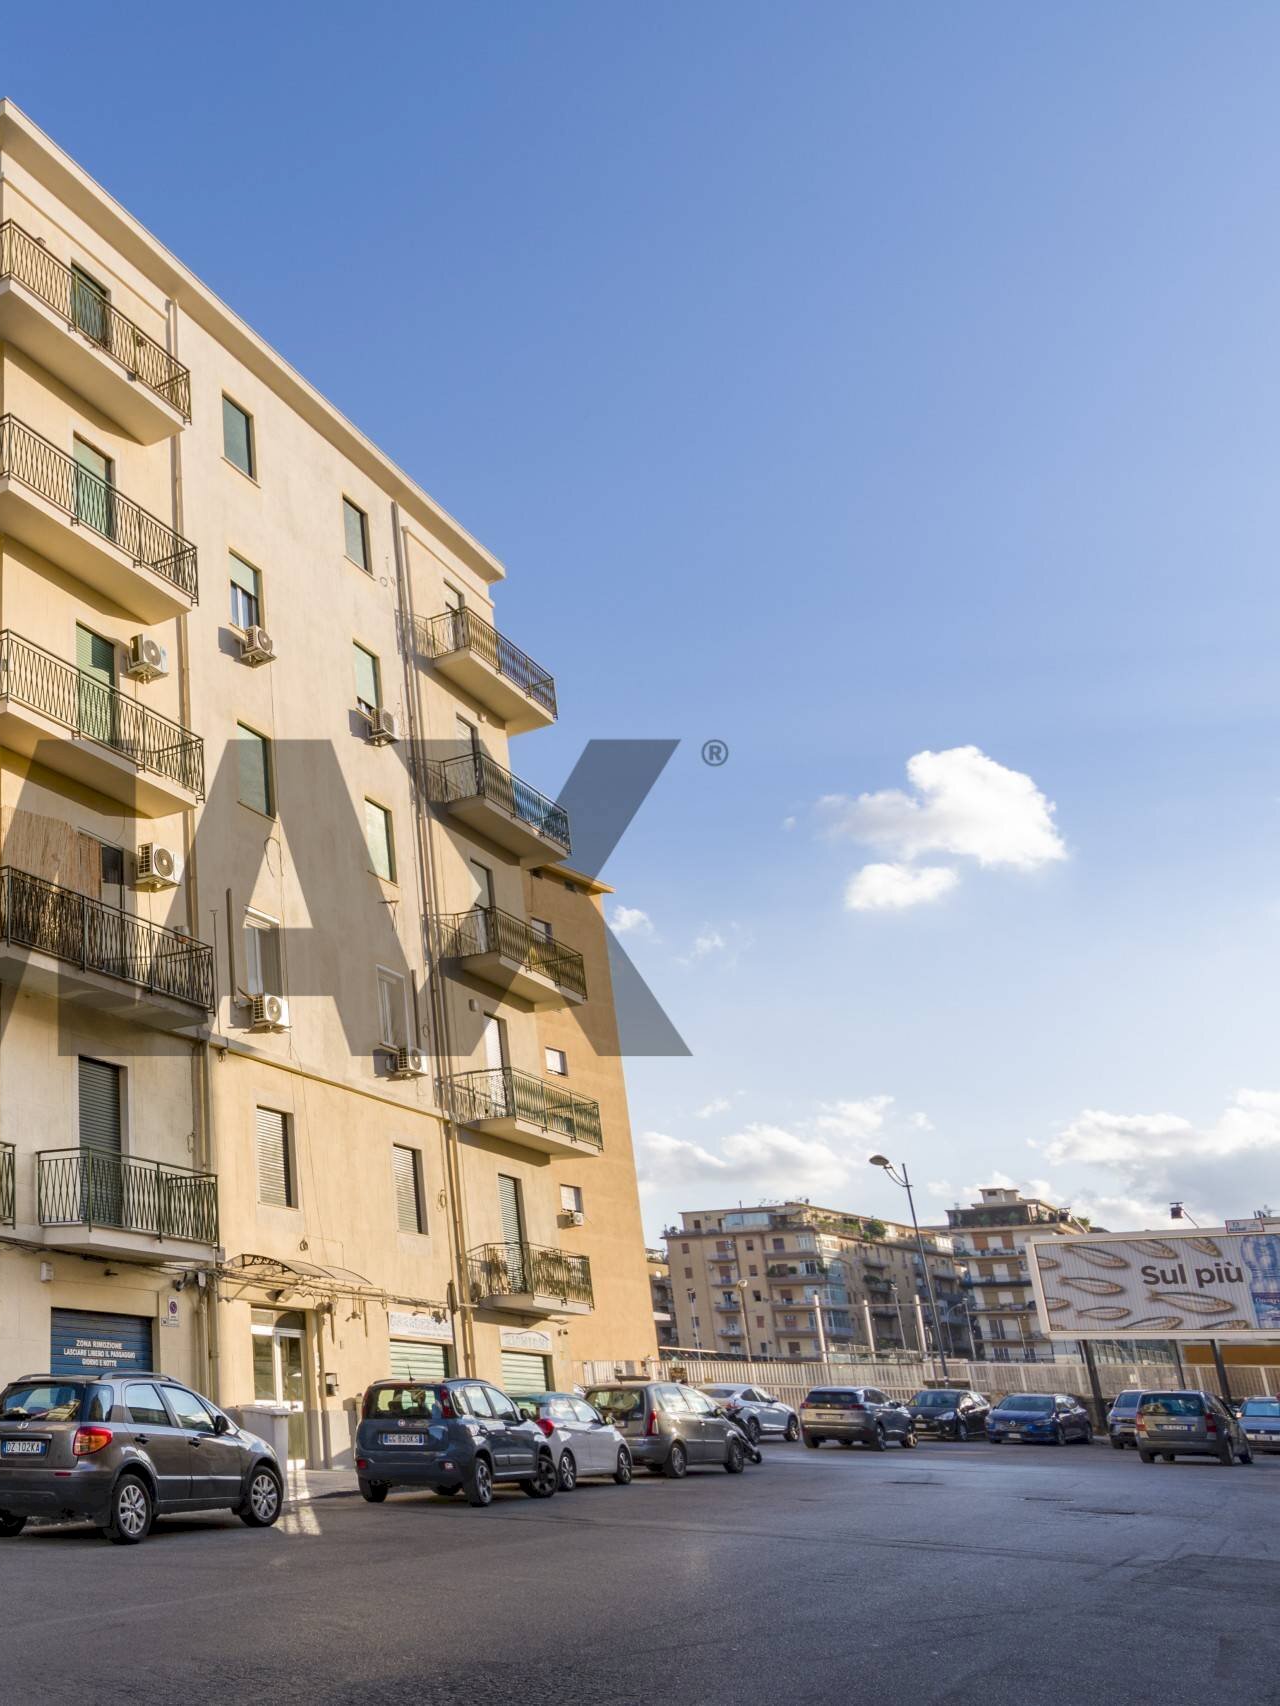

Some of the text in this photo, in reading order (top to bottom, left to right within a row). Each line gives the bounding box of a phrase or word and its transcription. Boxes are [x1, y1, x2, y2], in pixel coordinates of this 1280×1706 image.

[1141, 1261, 1244, 1288] Sul più
[76, 1339, 91, 1347] ZONA
